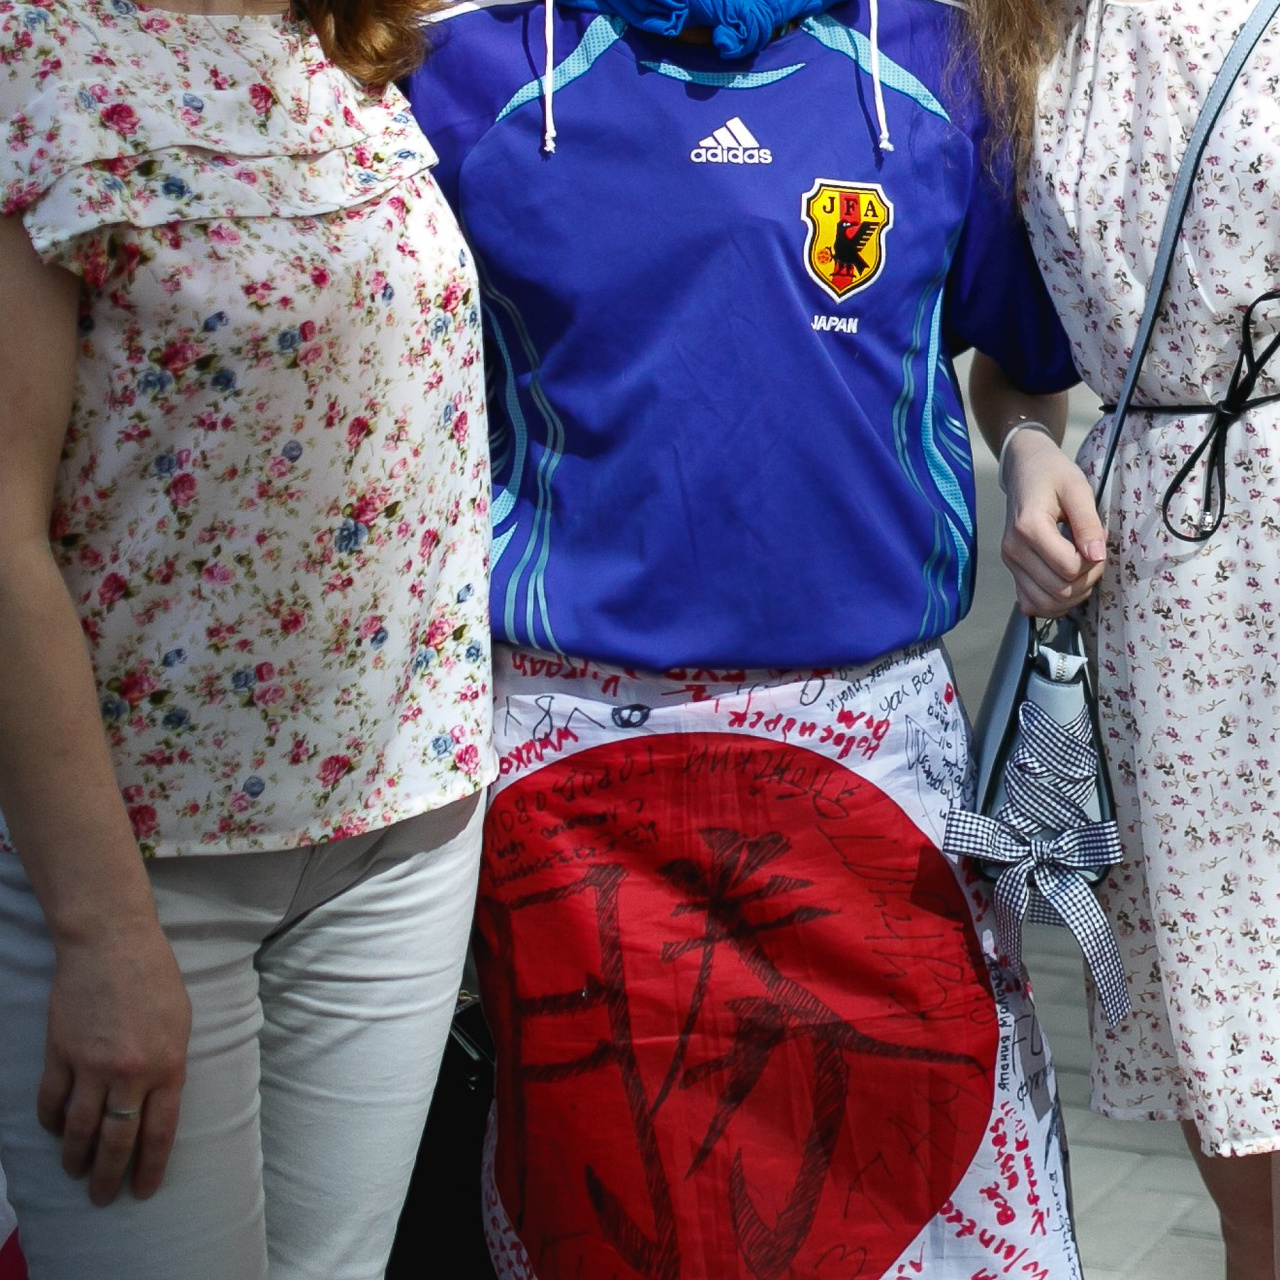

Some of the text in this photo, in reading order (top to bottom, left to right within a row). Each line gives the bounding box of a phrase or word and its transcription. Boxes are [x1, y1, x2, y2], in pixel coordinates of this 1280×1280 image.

[690, 146, 773, 164] adidas
[822, 196, 879, 218] JFA
[811, 315, 858, 333] JAPAN
